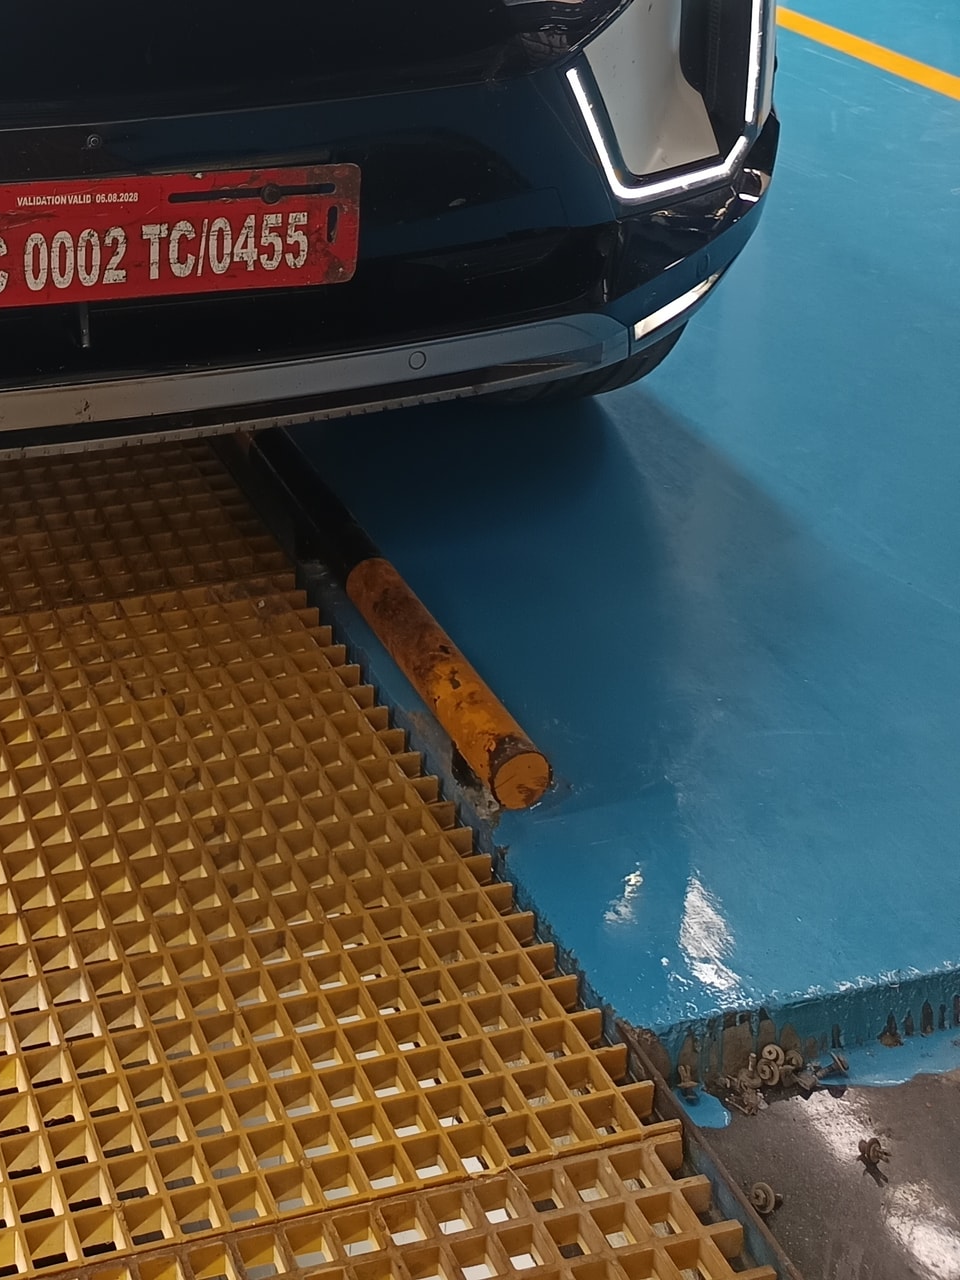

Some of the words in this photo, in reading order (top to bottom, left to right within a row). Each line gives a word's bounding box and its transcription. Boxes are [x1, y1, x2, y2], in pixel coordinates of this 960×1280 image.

[16, 195, 66, 206] VALIDATION
[68, 194, 91, 204] VALID
[24, 226, 127, 291] 0002
[142, 212, 308, 280] TC/0455
